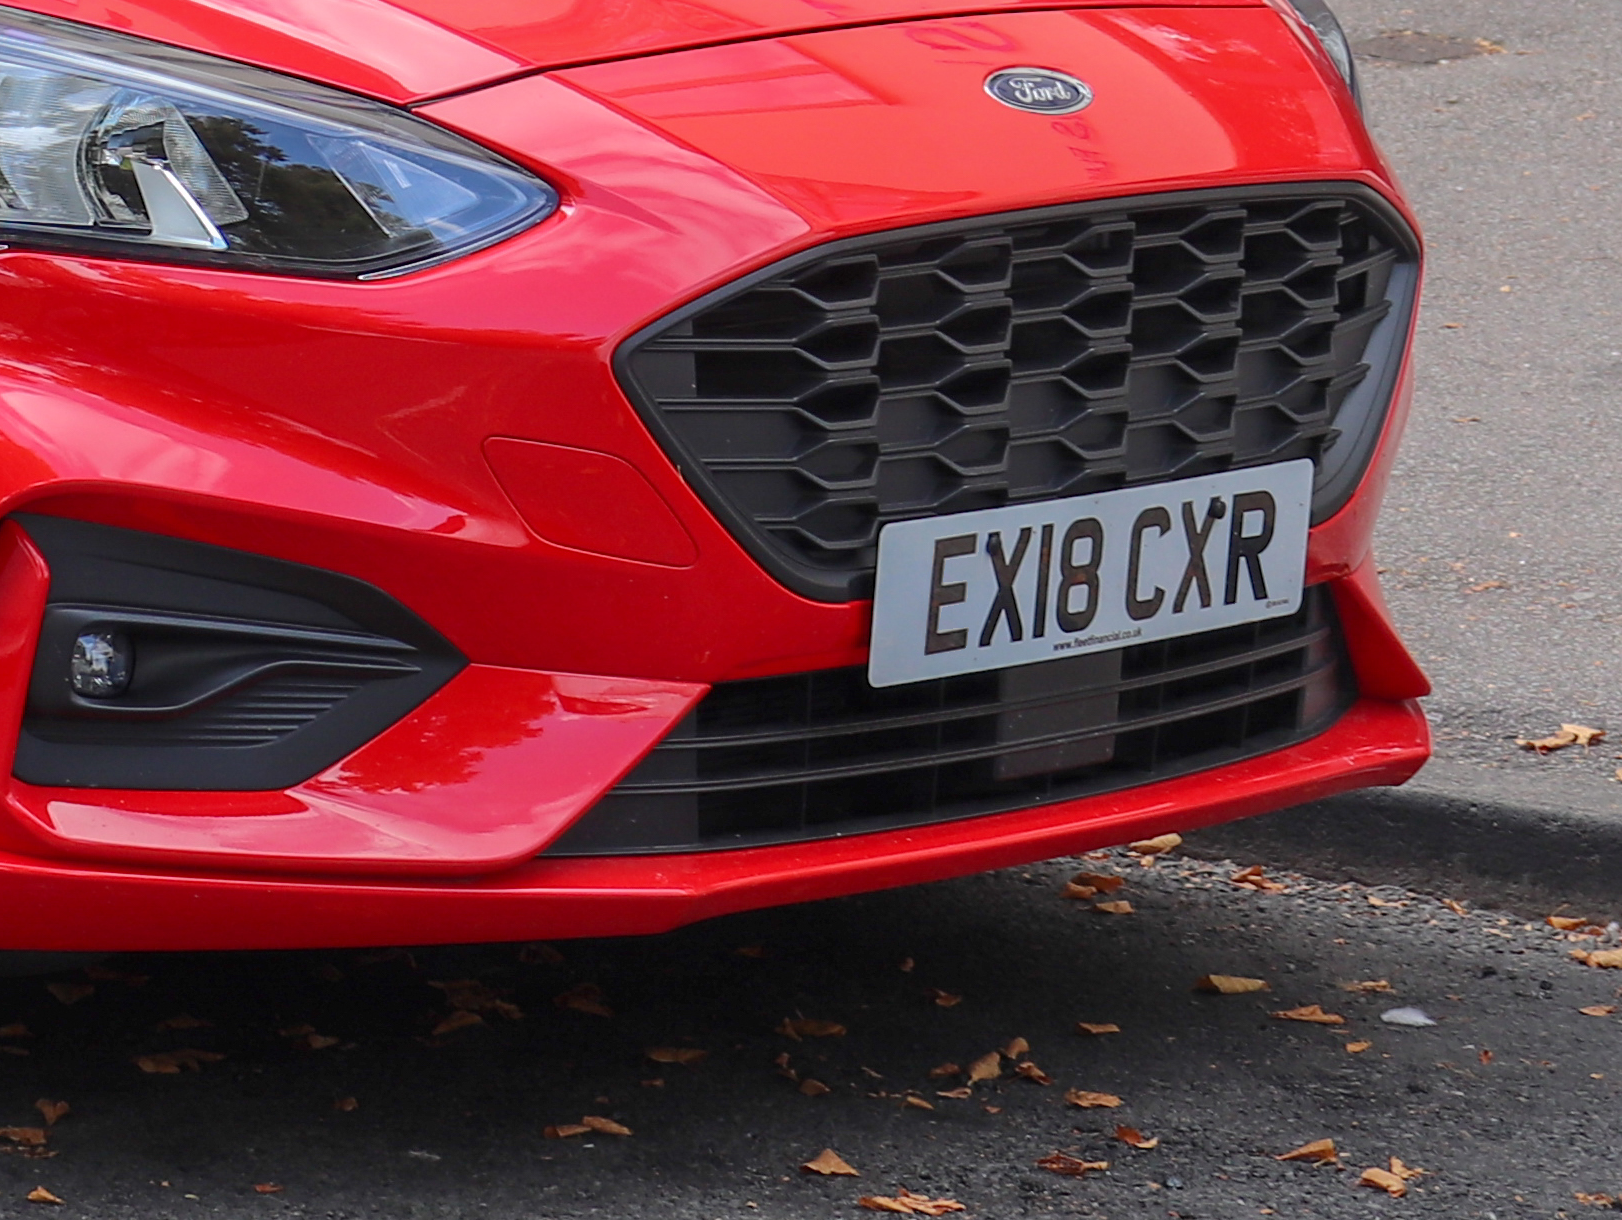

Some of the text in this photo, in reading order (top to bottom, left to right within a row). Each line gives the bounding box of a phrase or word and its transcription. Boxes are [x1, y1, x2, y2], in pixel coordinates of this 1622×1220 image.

[1008, 77, 1072, 103] Ford
[923, 489, 1277, 656] EX18 CXR
